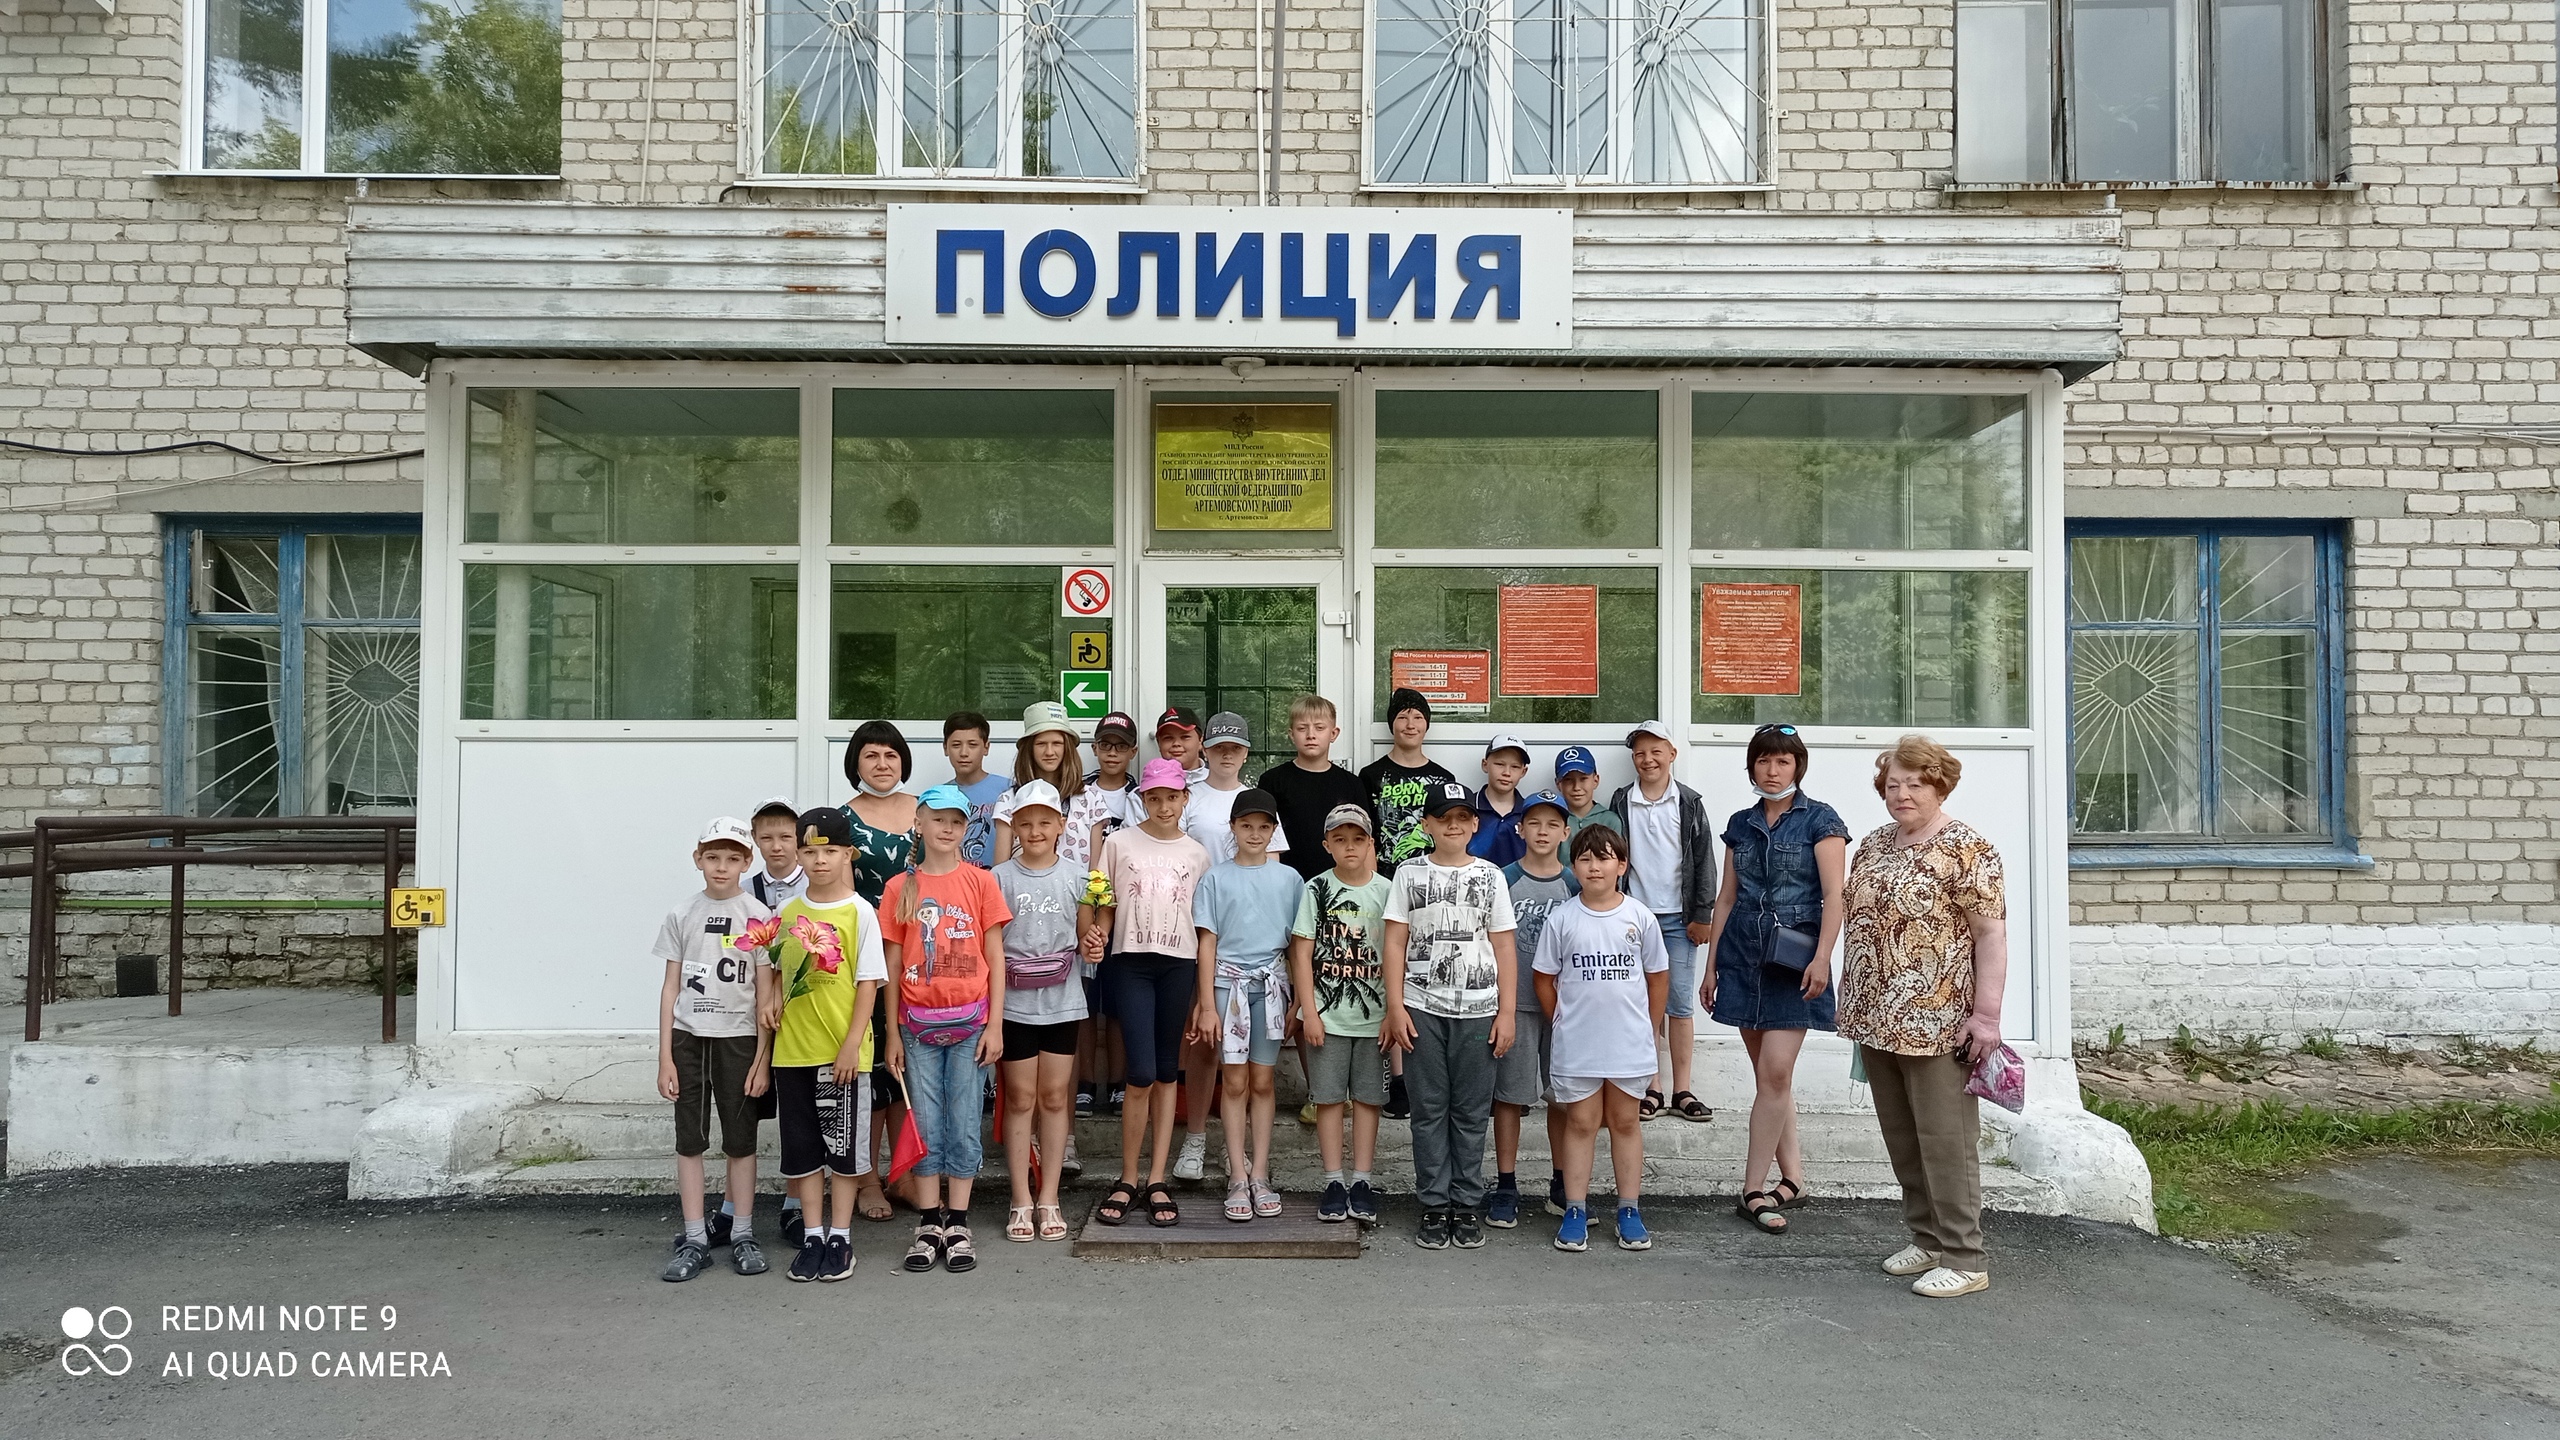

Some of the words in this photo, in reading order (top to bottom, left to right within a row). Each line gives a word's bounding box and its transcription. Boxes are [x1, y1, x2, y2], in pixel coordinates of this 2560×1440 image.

[936, 229, 1522, 337] ПОЛИЦИЯ
[1162, 468, 1188, 482] ОТДЕЛ
[1190, 468, 1254, 481] МИНИСТЕРСТВА
[1255, 468, 1309, 481] ВНУТРЕННИХ
[1310, 468, 1326, 482] ДЕЛ
[1185, 481, 1240, 497] РОССИЙСКОЙ
[1241, 484, 1289, 498] ФЕДЕРАЦИИ
[1291, 484, 1303, 497] ПО
[1194, 499, 1259, 512] АРТЕМОВСКОМУ
[1262, 497, 1293, 512] РАЙОНУ
[1712, 587, 1752, 596] Уважаемые
[1753, 589, 1792, 597] заявители!
[1381, 782, 1425, 798] BORN
[1393, 795, 1412, 808] TO
[1412, 791, 1429, 806] RI
[707, 916, 726, 924] OFF
[1323, 923, 1362, 939] LIVE
[1334, 945, 1372, 961] CALI
[1571, 951, 1636, 968] Emirates
[1321, 962, 1383, 980] FORNIA
[1582, 969, 1596, 981] FLY
[1600, 969, 1630, 981] BETTER
[836, 1130, 844, 1157] NOT
